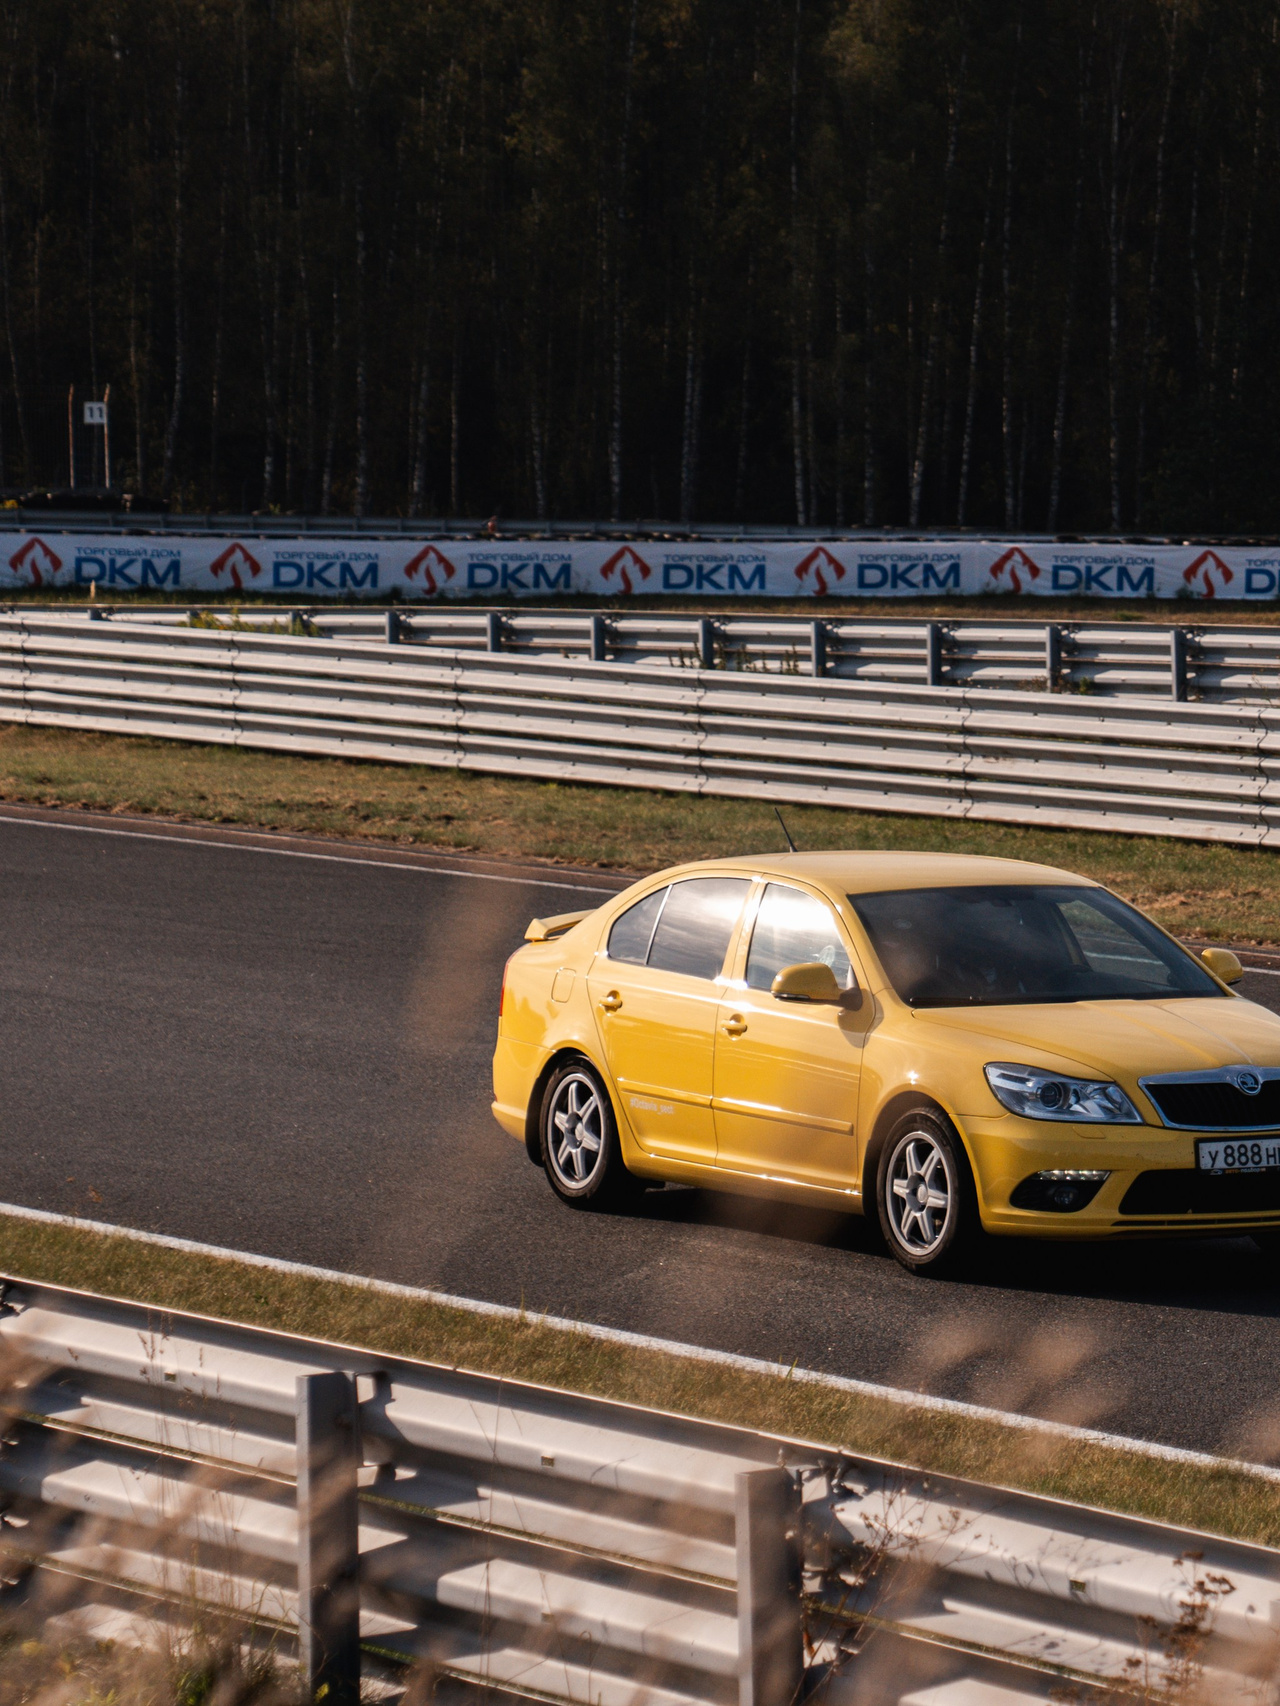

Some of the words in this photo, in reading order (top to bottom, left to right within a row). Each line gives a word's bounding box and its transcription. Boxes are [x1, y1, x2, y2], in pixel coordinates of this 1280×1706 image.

[87, 406, 104, 419] 11
[76, 547, 147, 558] ТОРГОВЫЙ
[150, 549, 181, 559] ДОМ
[274, 551, 345, 560] ТОРГОВЫЙ
[348, 552, 379, 561] ДОМ
[469, 552, 539, 561] ТОРГОВЫЙ
[541, 553, 572, 562] ДОМ
[664, 553, 733, 562] ТОРГОВЫЙ
[736, 554, 767, 563] ДОМ
[859, 553, 928, 562] ТОРГОВЫЙ
[930, 553, 961, 562] ДОМ
[1053, 555, 1122, 564] ТОРГОВЫЙ
[1125, 556, 1155, 565] ДОМ
[74, 556, 181, 586] DKM
[273, 561, 378, 589] DKM
[467, 563, 571, 590] DKM
[663, 564, 766, 590] DKM
[857, 563, 960, 590] DKM
[1052, 565, 1154, 592] DKM
